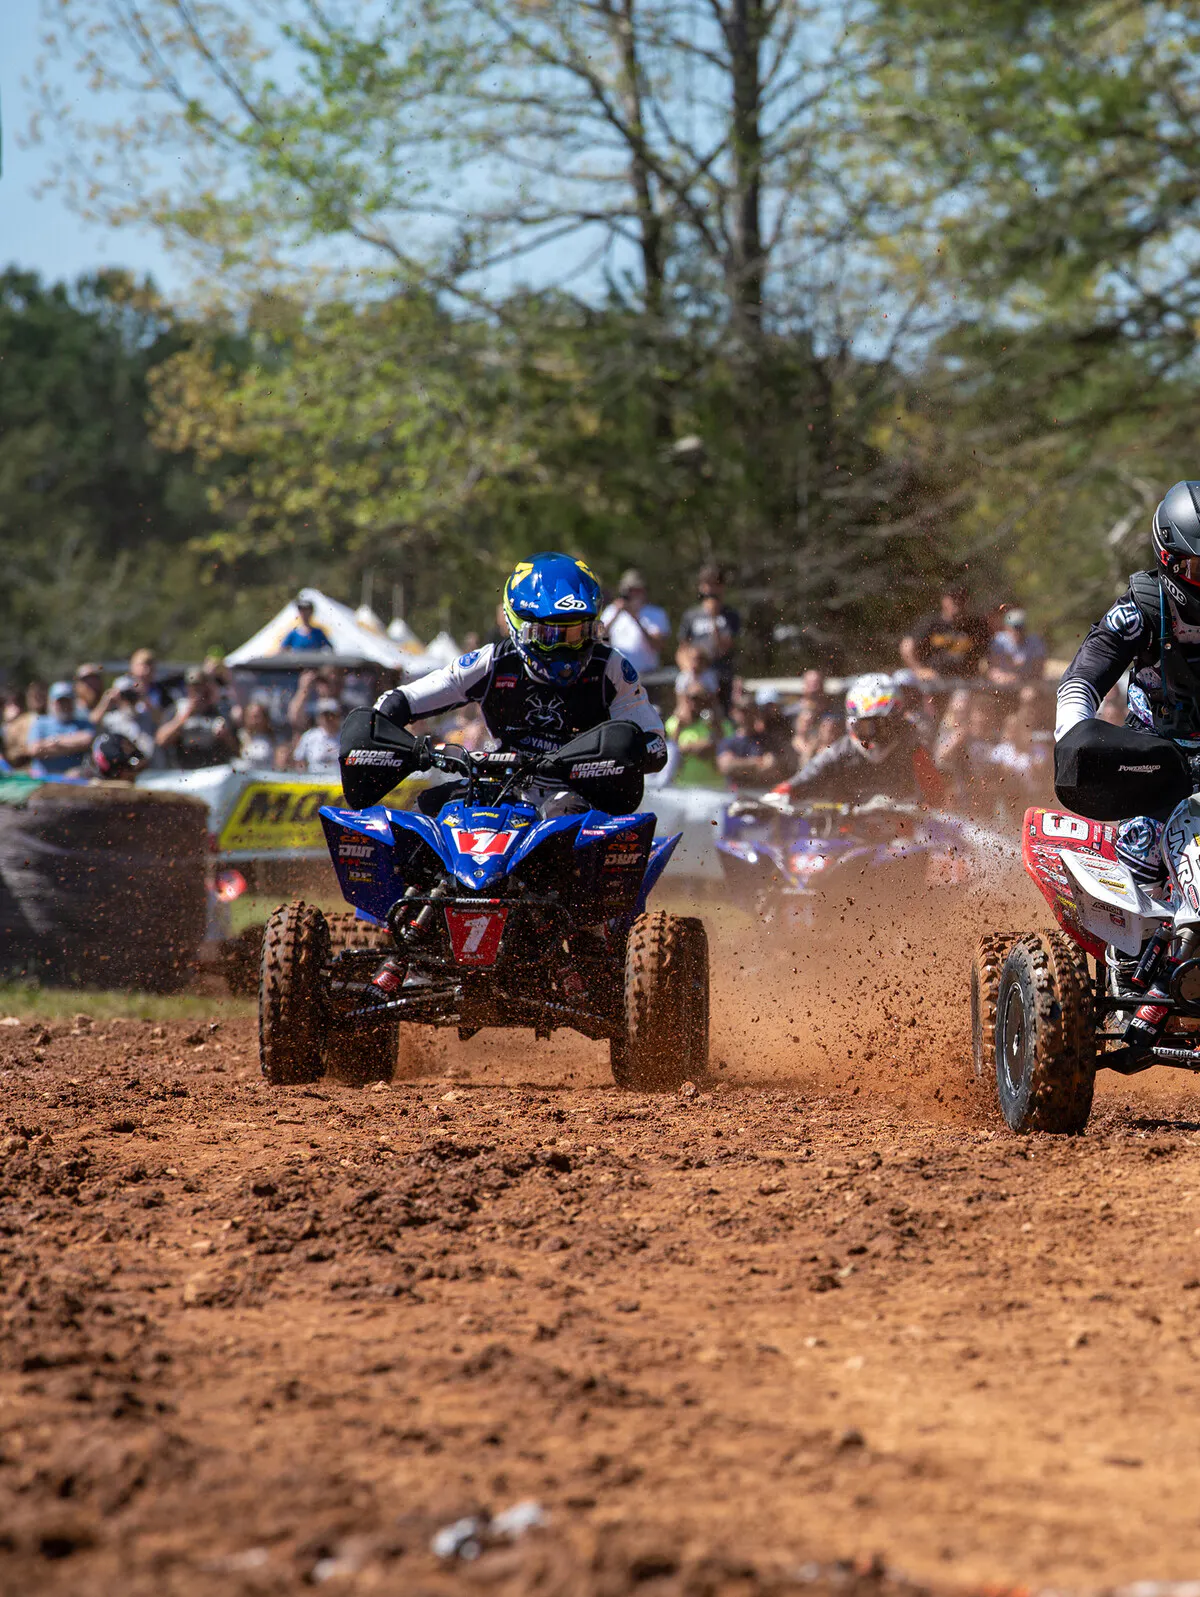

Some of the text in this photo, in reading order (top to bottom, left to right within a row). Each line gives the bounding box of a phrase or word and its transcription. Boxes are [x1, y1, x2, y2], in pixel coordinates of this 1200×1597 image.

[349, 750, 395, 758] MOOSE
[354, 758, 403, 767] RACING
[571, 760, 616, 772] MOOSE
[578, 766, 625, 779] RACING
[470, 832, 497, 853] 1
[461, 916, 491, 953] 1
[1144, 953, 1157, 972] Elka
[1130, 1017, 1157, 1035] Elka
